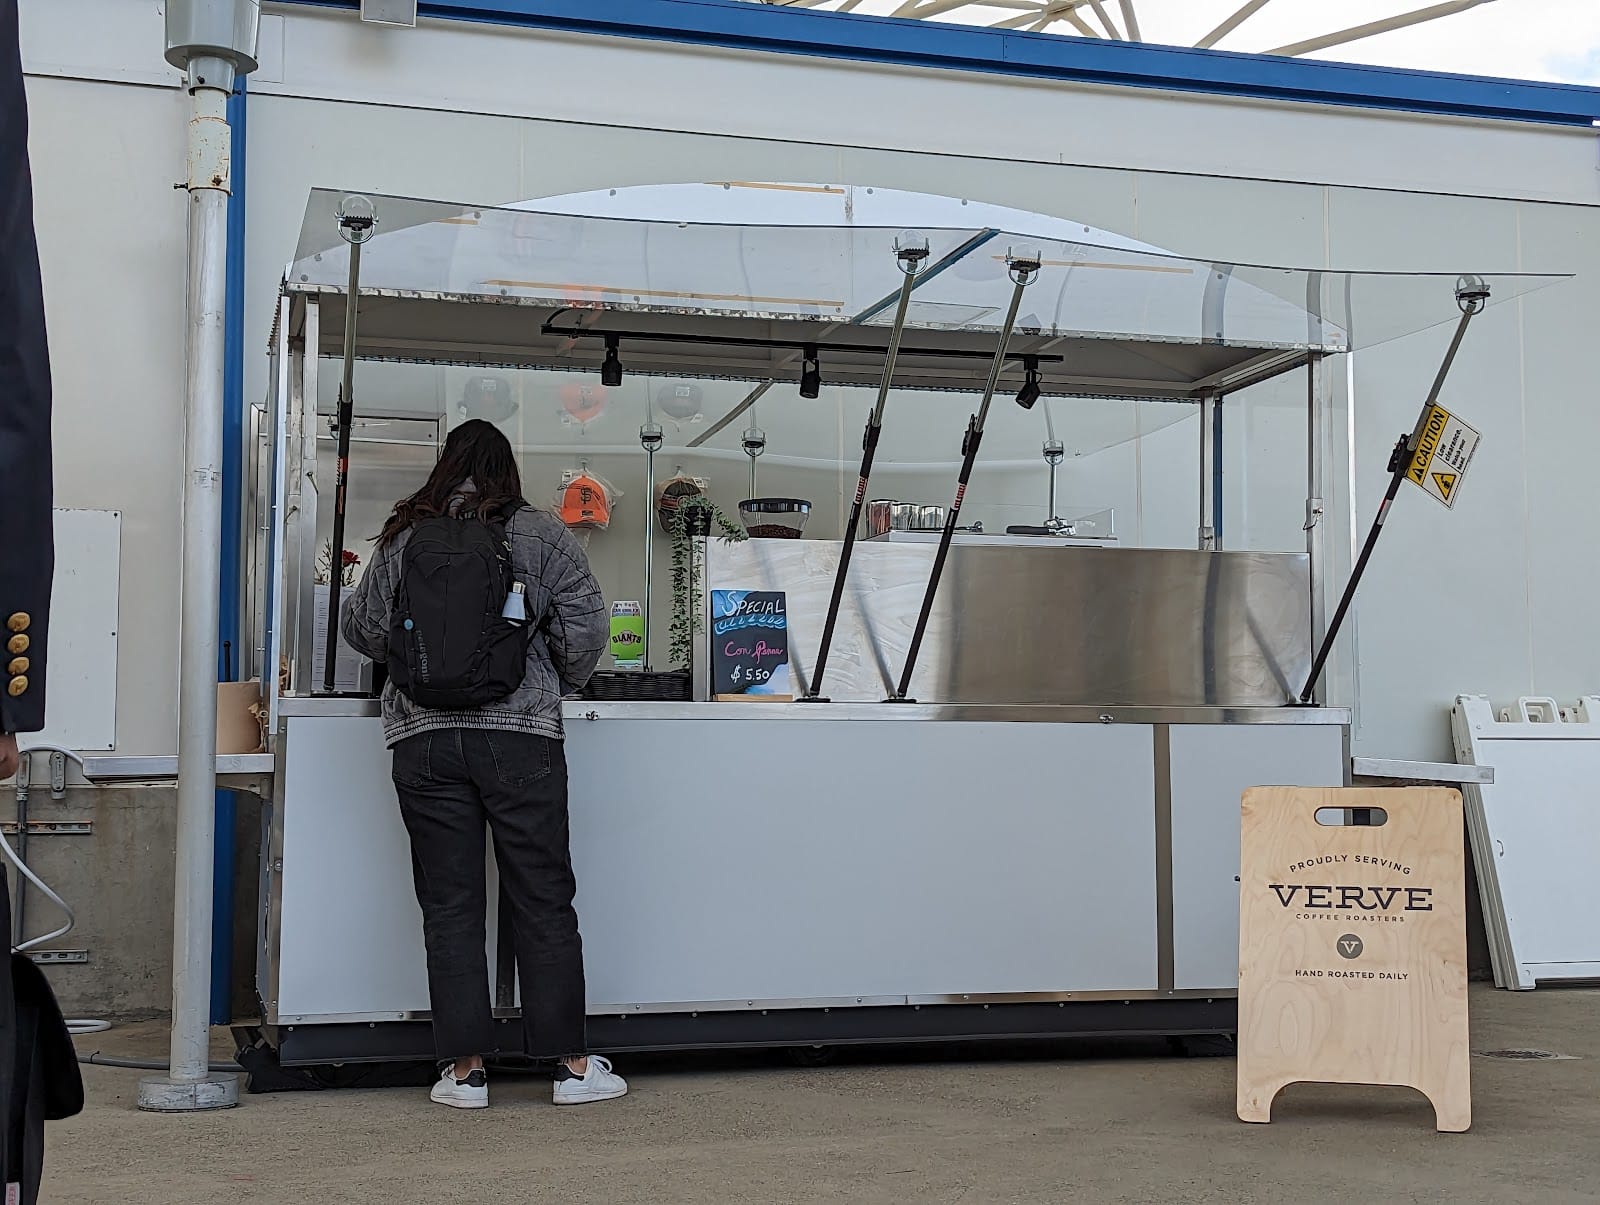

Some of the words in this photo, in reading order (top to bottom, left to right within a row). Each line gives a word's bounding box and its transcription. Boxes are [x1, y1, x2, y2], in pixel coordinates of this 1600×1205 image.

[1416, 410, 1445, 467] CAUTION
[1437, 443, 1446, 457] Low
[722, 591, 785, 617] SPECIAL
[612, 633, 642, 644] GIANTS
[745, 668, 770, 681] 5.50
[1289, 855, 1348, 873] PROUDLY
[1354, 855, 1411, 875] SERVING
[1268, 884, 1433, 911] VERVE
[1296, 913, 1339, 921] COFFEE
[1346, 915, 1405, 923] ROASTERS
[1295, 969, 1323, 978] HAND
[1327, 970, 1375, 979] ROASTED
[1379, 971, 1409, 980] DAILY
